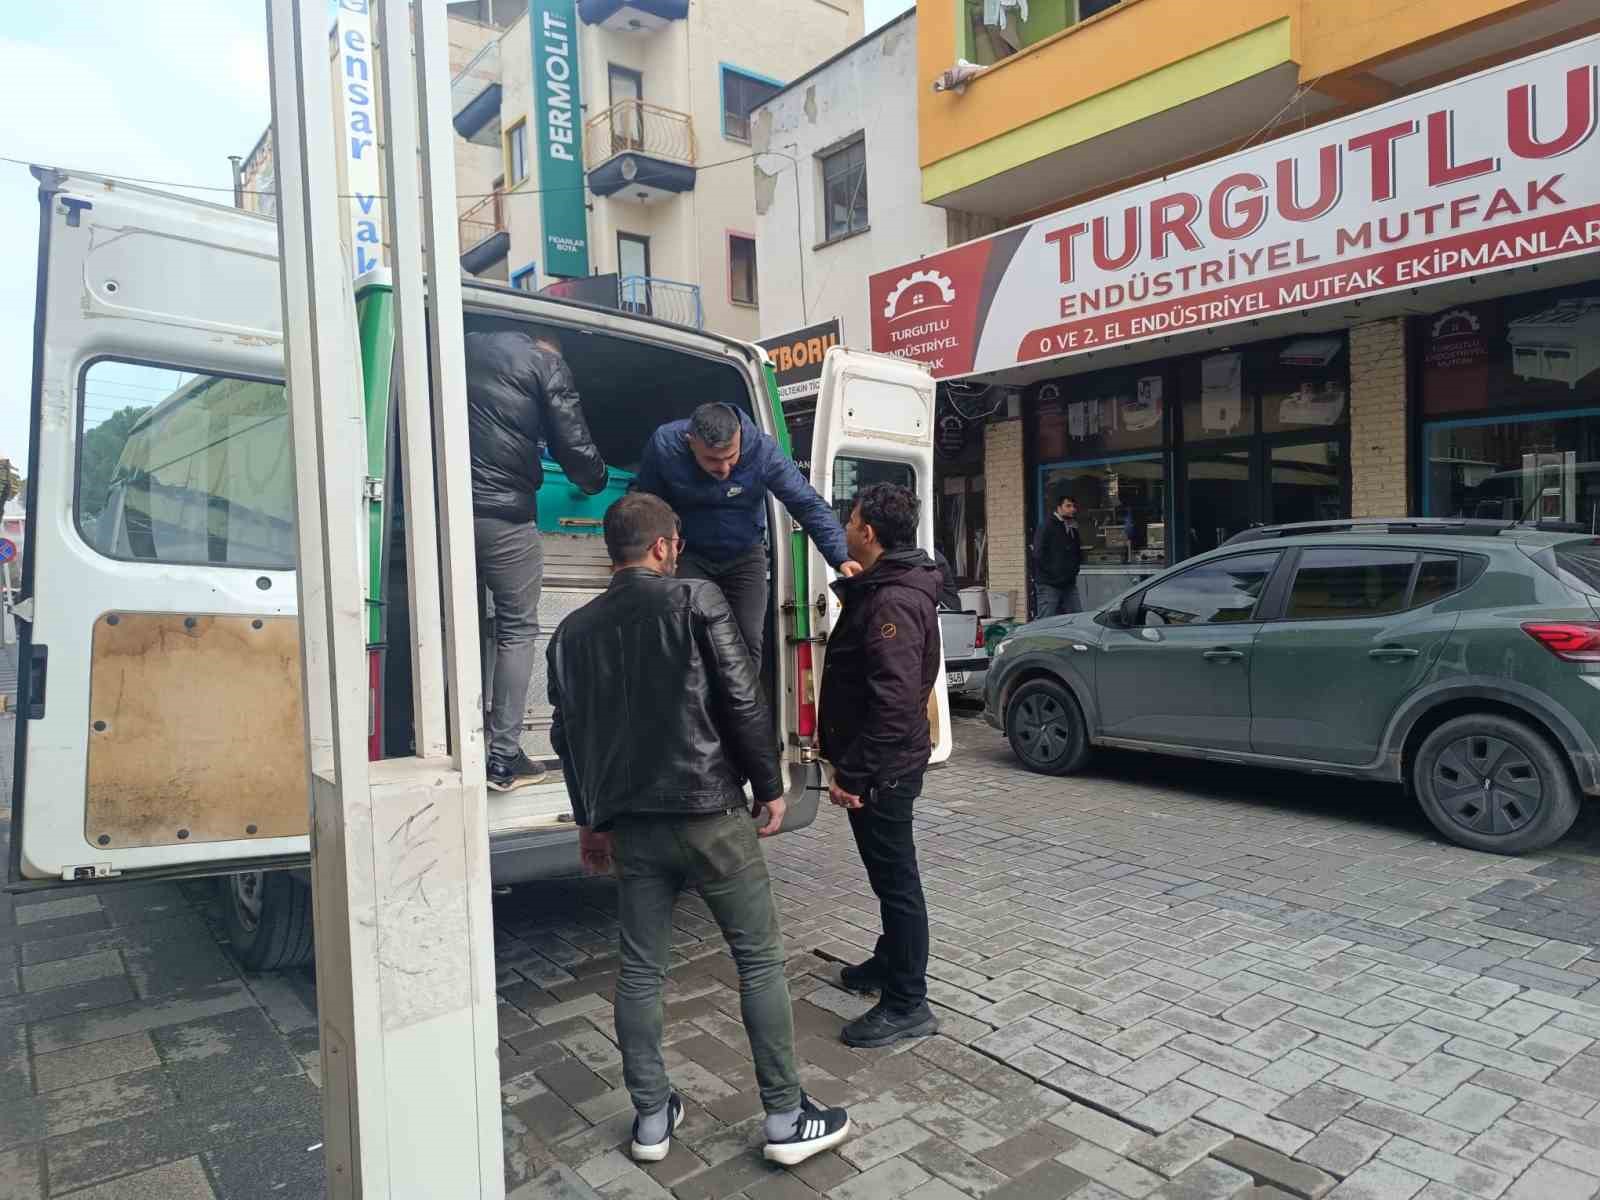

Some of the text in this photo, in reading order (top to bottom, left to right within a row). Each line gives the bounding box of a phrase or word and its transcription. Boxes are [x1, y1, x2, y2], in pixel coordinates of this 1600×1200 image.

[344, 29, 373, 159] ensar
[1045, 64, 1598, 284] TURGUTLU
[1060, 173, 1566, 319] ENDÜSTRİYEL MUTFAK
[889, 336, 959, 361] NDÜSTRİYEL
[890, 319, 950, 342] TURGUTLU
[1057, 331, 1079, 349] VE
[1084, 328, 1099, 344] 2.
[1104, 323, 1125, 340] EL
[1131, 292, 1270, 335] ENDÜSTRİYEL
[1279, 266, 1384, 305] MUTFAK
